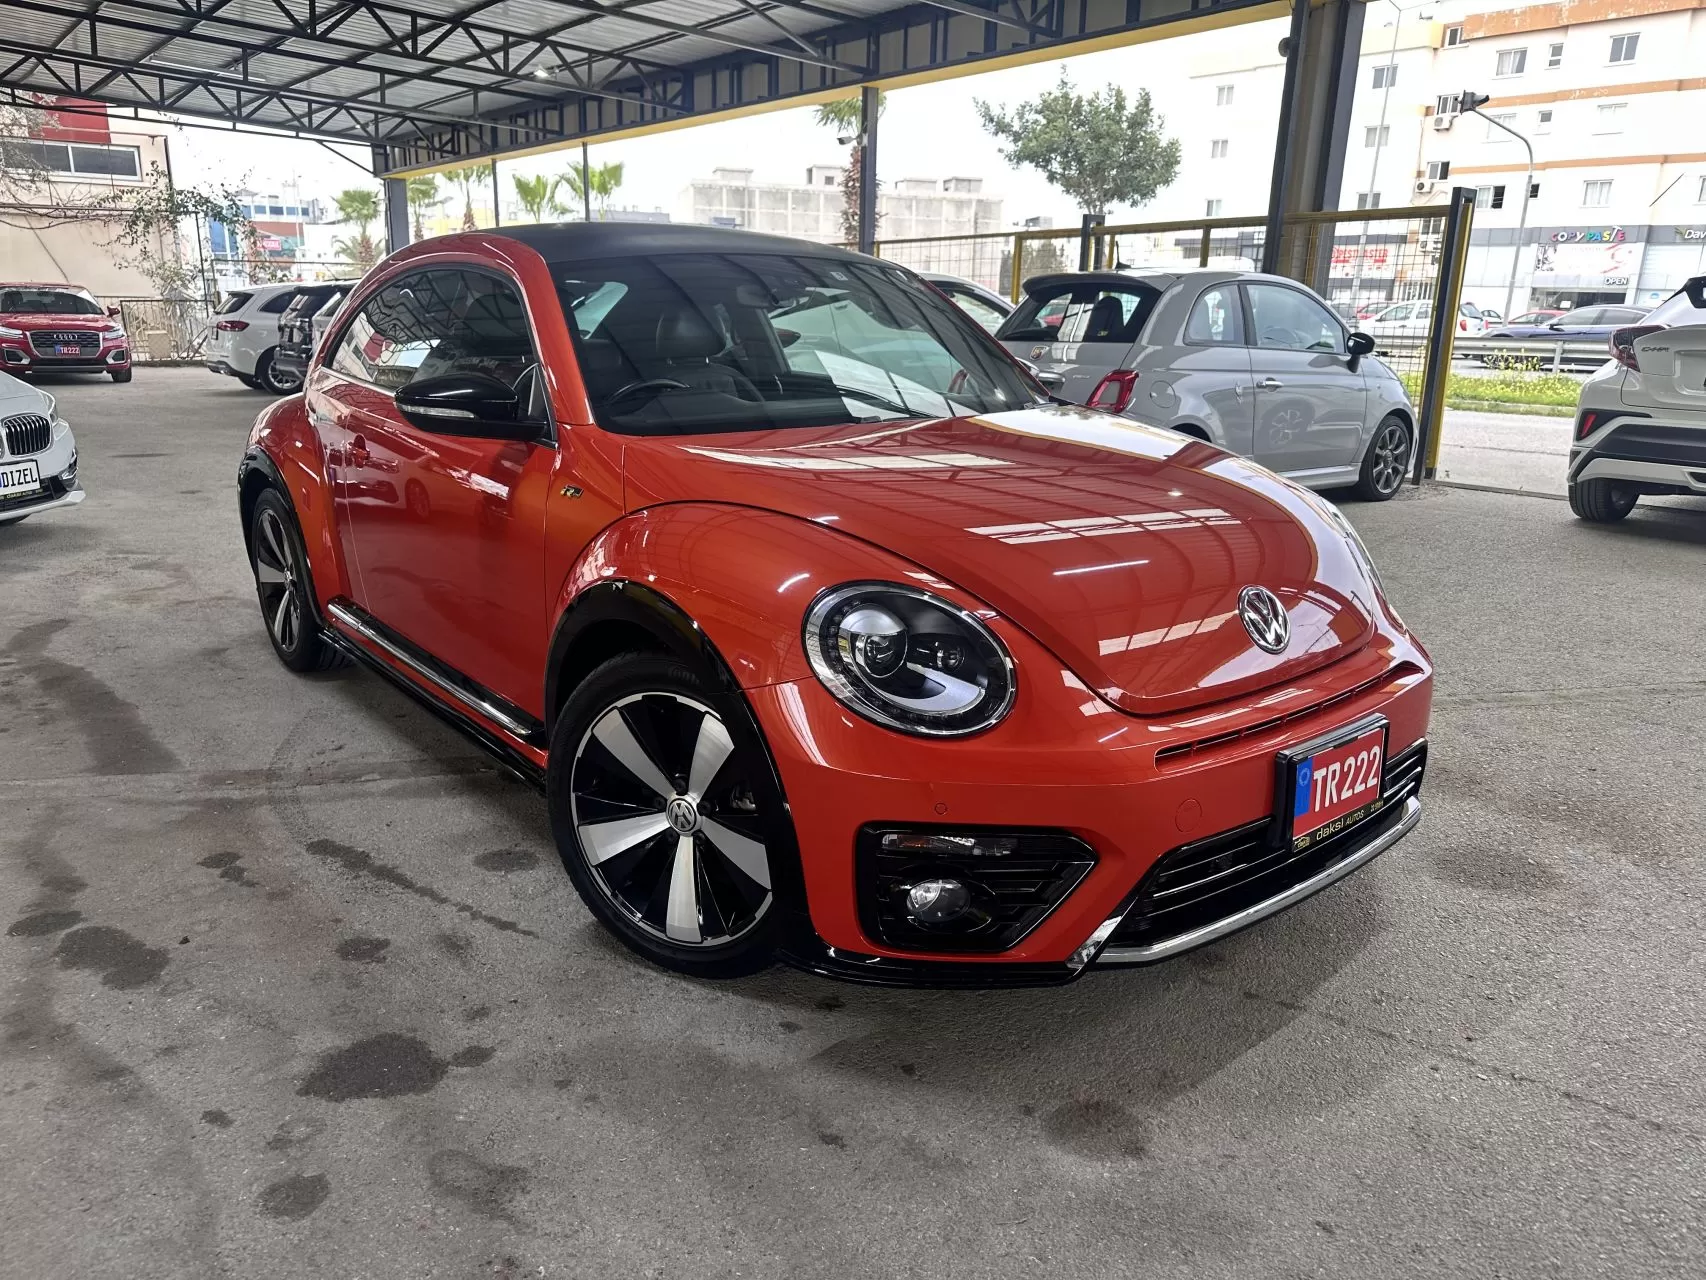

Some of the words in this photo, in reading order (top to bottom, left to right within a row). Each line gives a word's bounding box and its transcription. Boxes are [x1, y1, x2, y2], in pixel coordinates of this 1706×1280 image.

[1552, 231, 1585, 242] COPY
[1587, 225, 1625, 242] PASTE
[1604, 277, 1629, 286] OPEN
[1, 467, 38, 488] DIZEL
[1313, 745, 1380, 812] TR222
